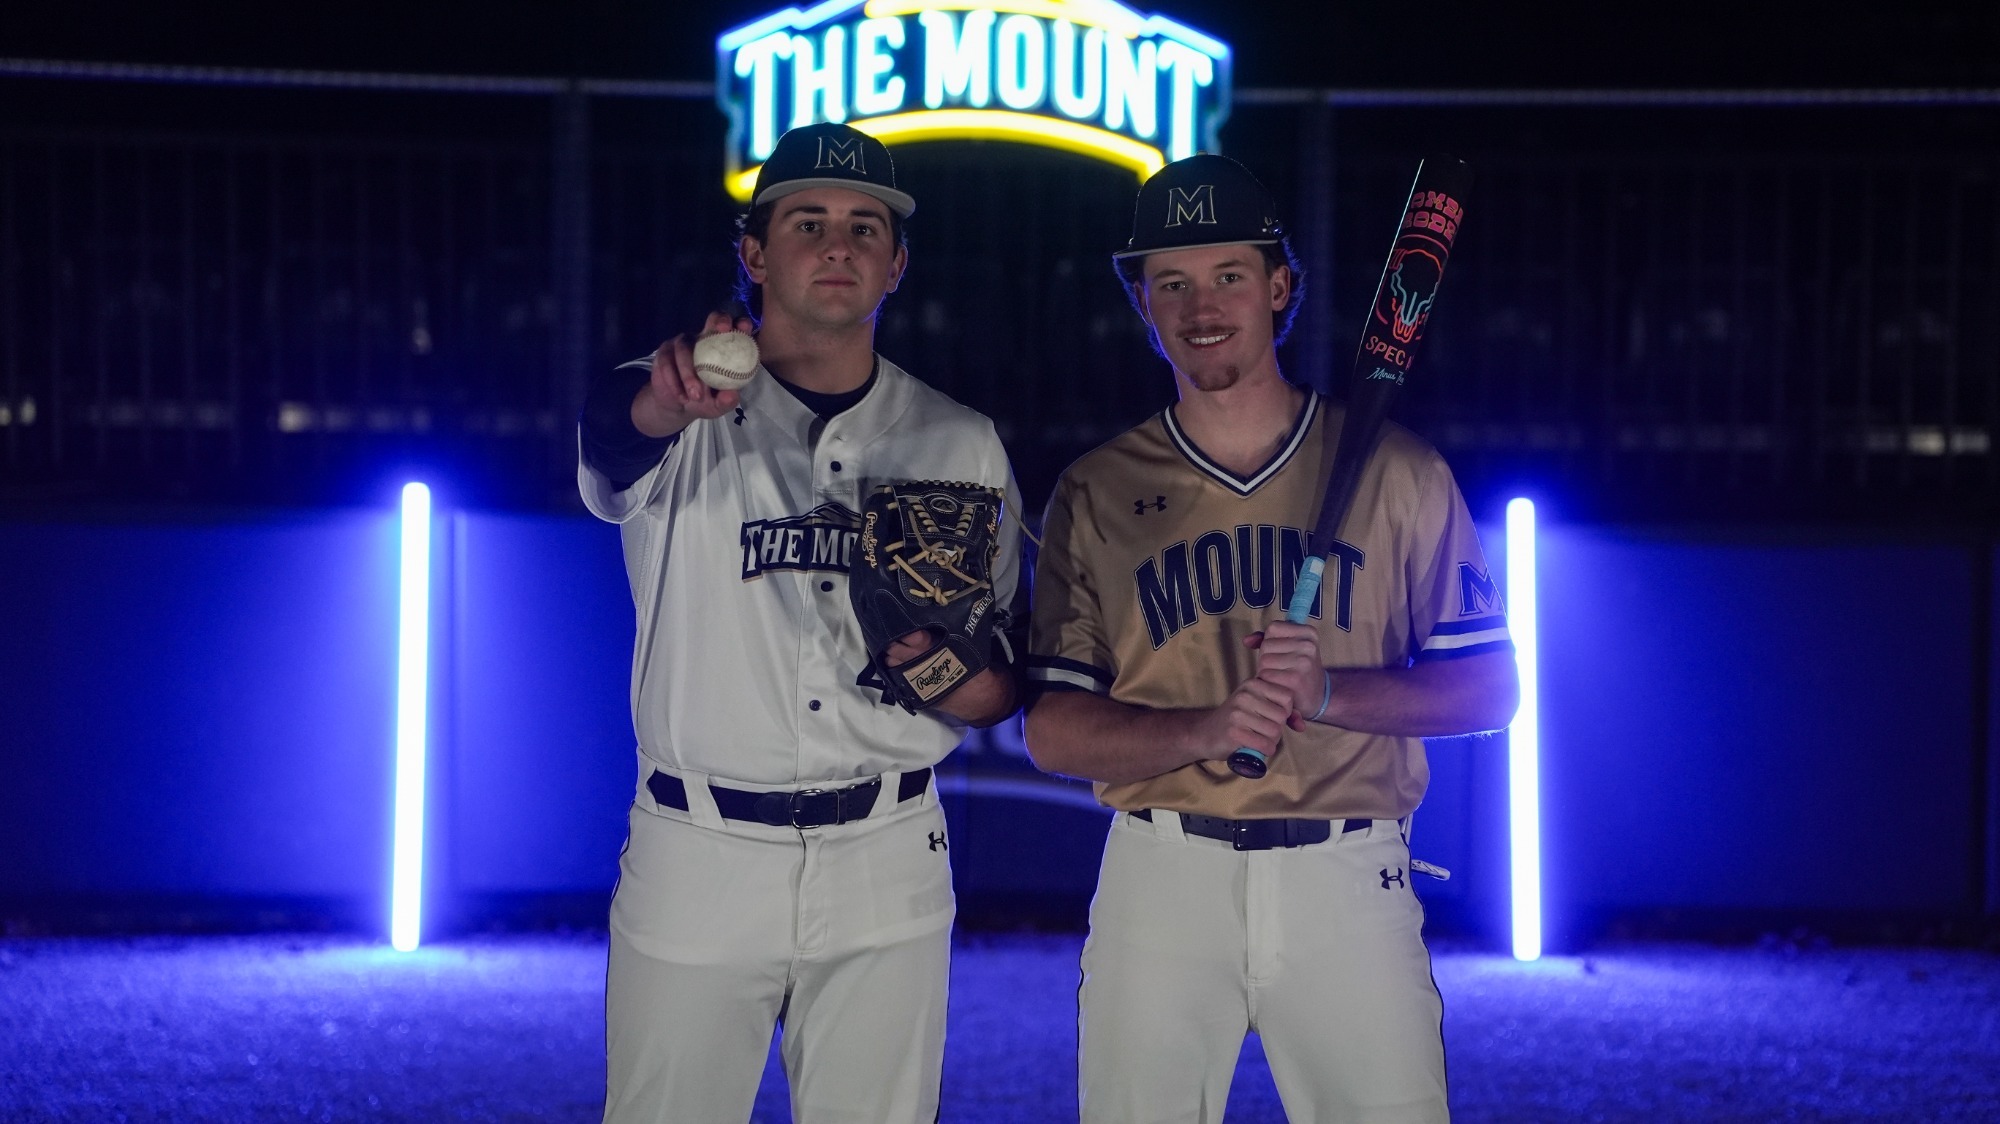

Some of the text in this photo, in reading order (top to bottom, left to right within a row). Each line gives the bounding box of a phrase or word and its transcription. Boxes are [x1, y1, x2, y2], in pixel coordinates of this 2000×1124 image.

[734, 9, 1213, 164] THE MOUNT
[814, 136, 867, 175] M
[1164, 184, 1217, 228] M
[746, 525, 860, 571] THE MO
[863, 511, 878, 569] Rawlings
[1134, 524, 1366, 651] MOUNT
[965, 591, 994, 637] THE MOUNT
[917, 658, 951, 690] Rawlings
